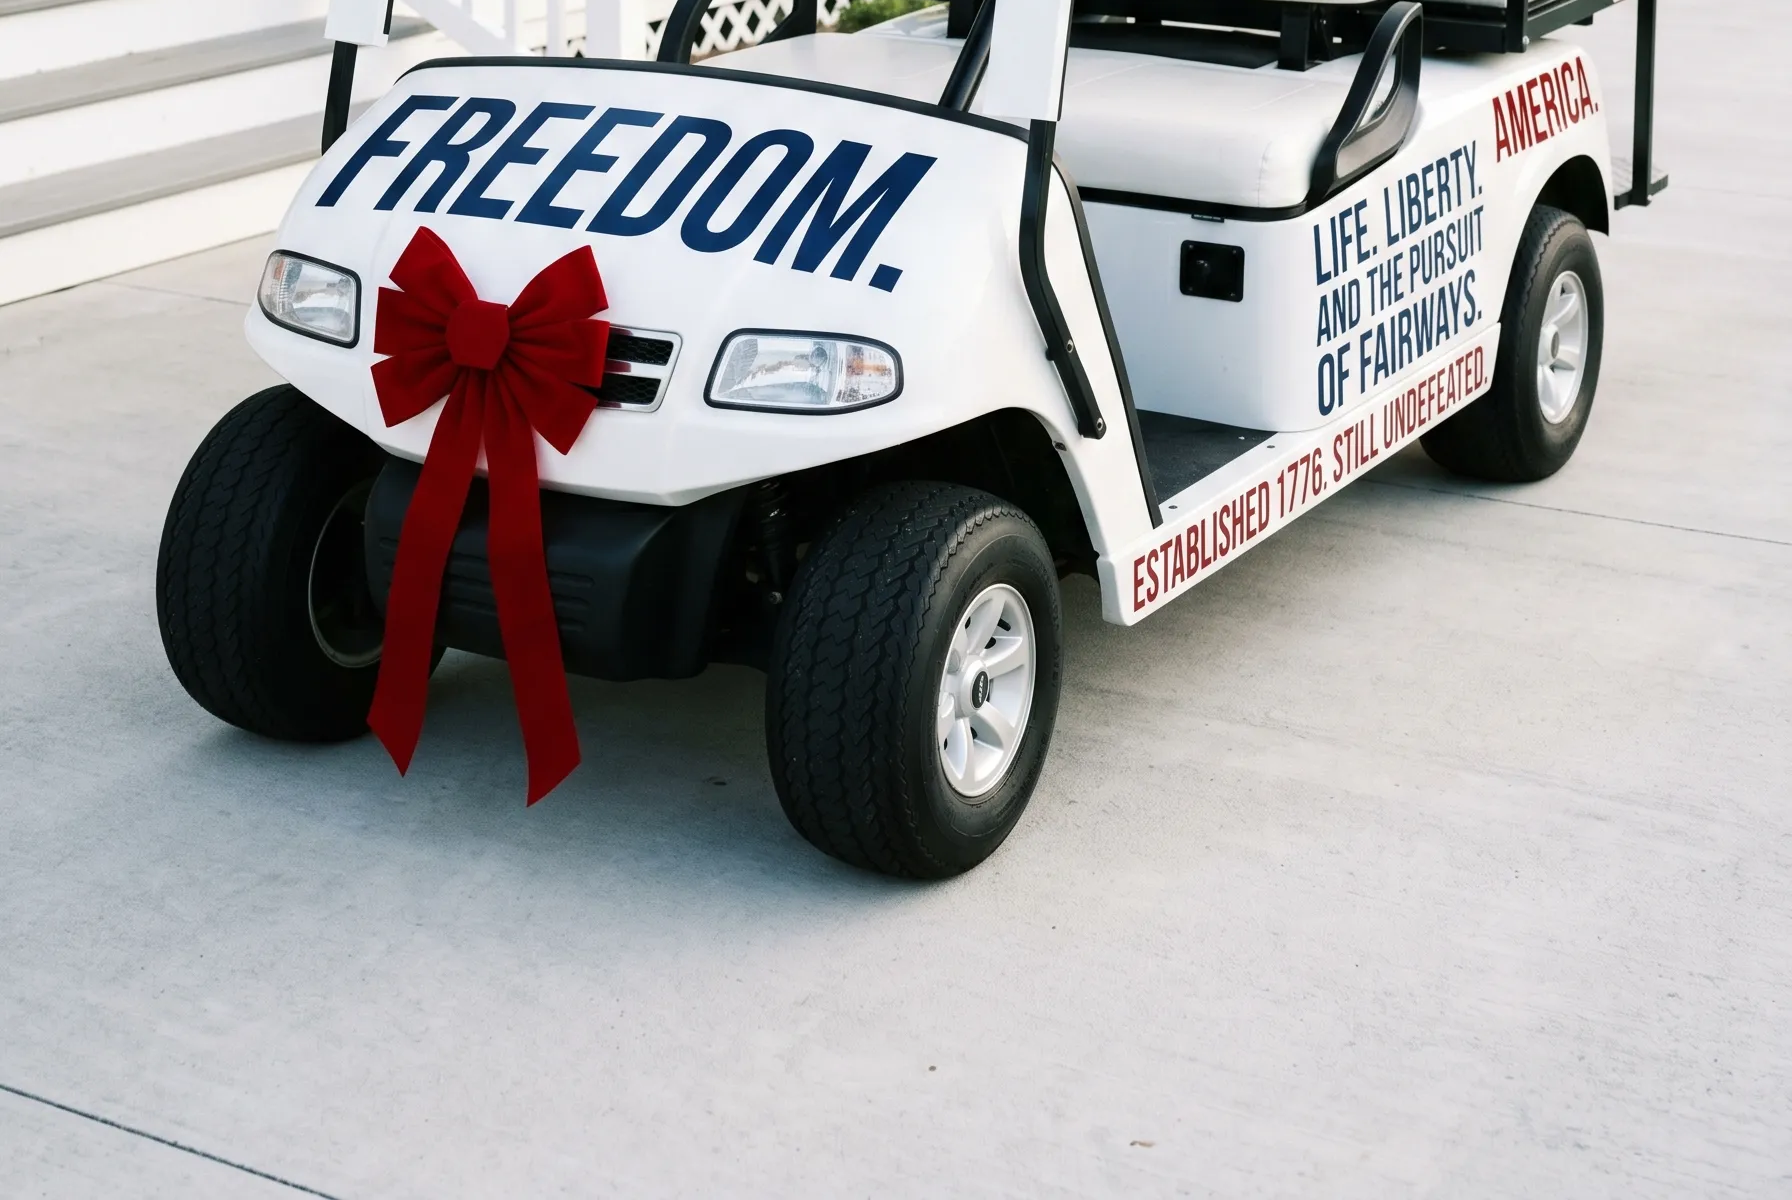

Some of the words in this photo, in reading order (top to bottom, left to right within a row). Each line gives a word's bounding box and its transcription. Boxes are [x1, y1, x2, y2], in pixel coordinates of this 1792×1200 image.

[1492, 56, 1599, 163] AMERICA.
[315, 94, 938, 293] FREEDOM.
[1313, 198, 1377, 287] LIFE.
[1383, 139, 1483, 248] LIBERTY.
[1316, 278, 1361, 347] AND
[1366, 252, 1404, 317] THE
[1409, 205, 1484, 294] PURSUIT
[1317, 342, 1350, 417] OF
[1360, 268, 1482, 395] FAIRWAYS.
[1133, 480, 1271, 613] ESTABLISHED
[1276, 447, 1327, 519] 1776.
[1333, 412, 1379, 484] STILL
[1383, 345, 1488, 449] UNDEFEATED.
